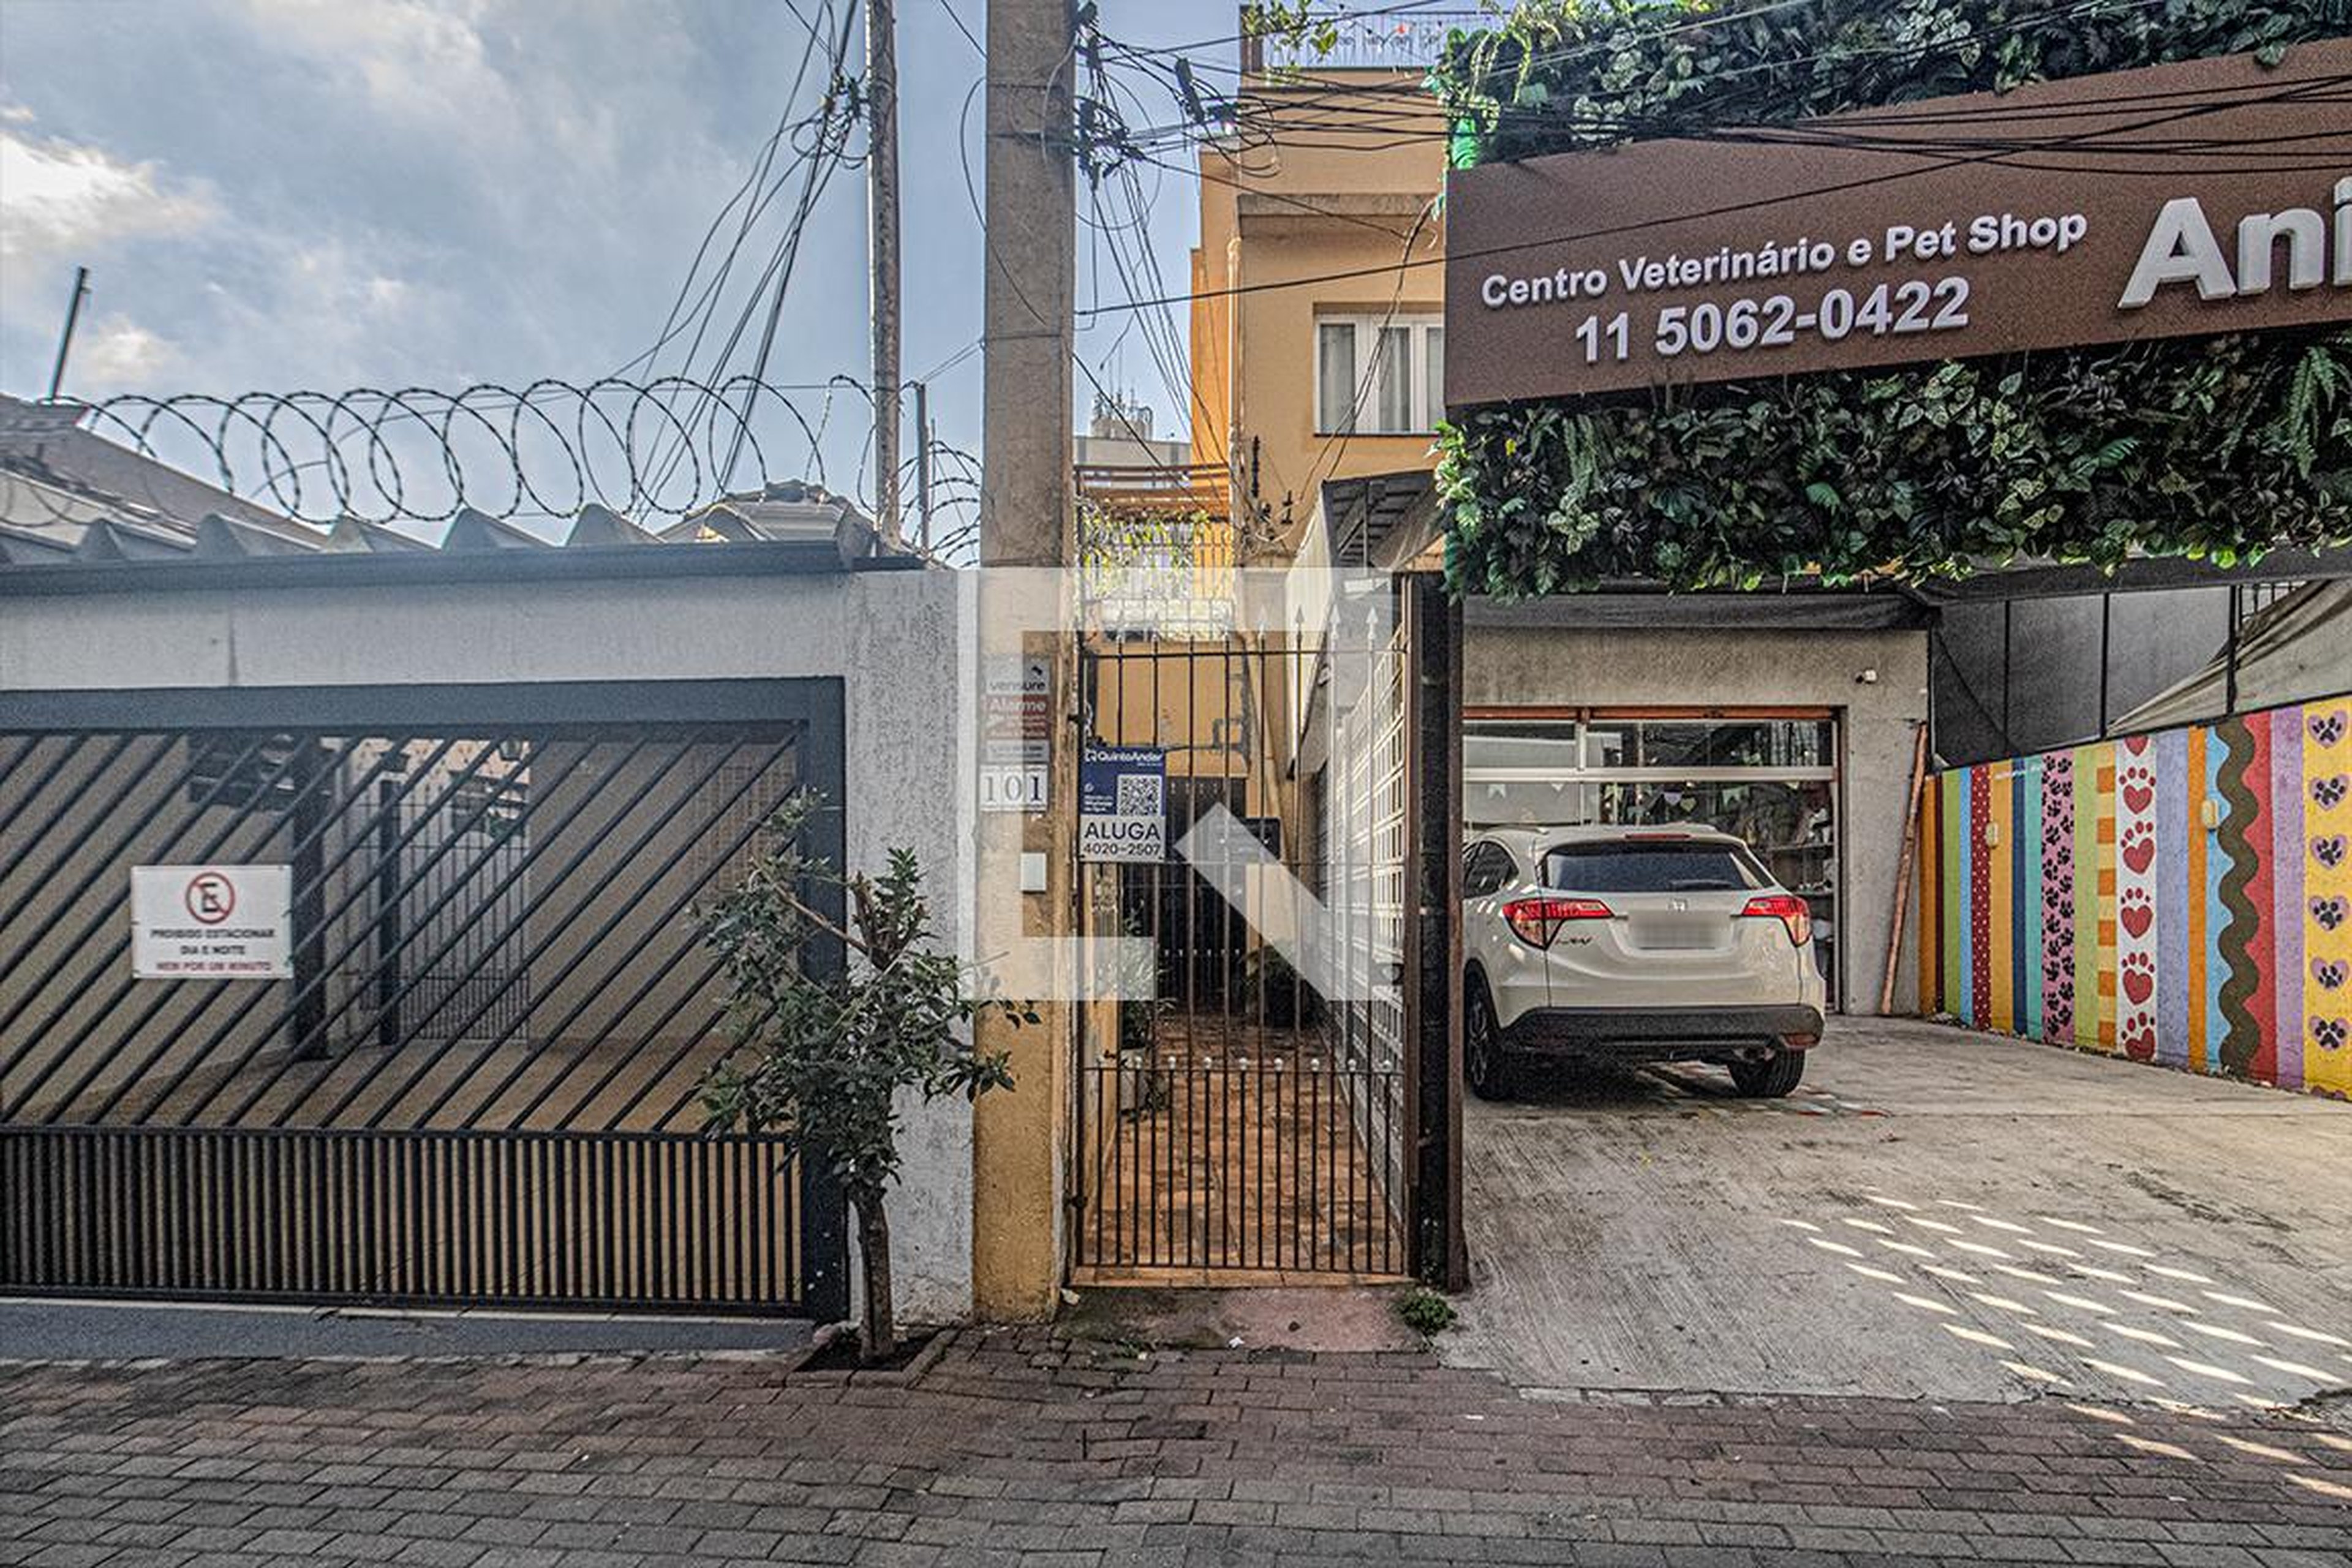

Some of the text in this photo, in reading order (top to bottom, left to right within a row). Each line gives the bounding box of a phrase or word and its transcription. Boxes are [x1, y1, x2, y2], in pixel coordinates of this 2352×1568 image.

[1482, 213, 2088, 306] Centro Veterinário e Pet Shop
[1575, 276, 1970, 363] 11 5062-0422
[986, 775, 1040, 803] 101
[1084, 822, 1161, 840] ALUGA
[1084, 843, 1161, 856] 4020-2507
[150, 929, 203, 939] PROIBIDO
[180, 945, 198, 955] DIA
